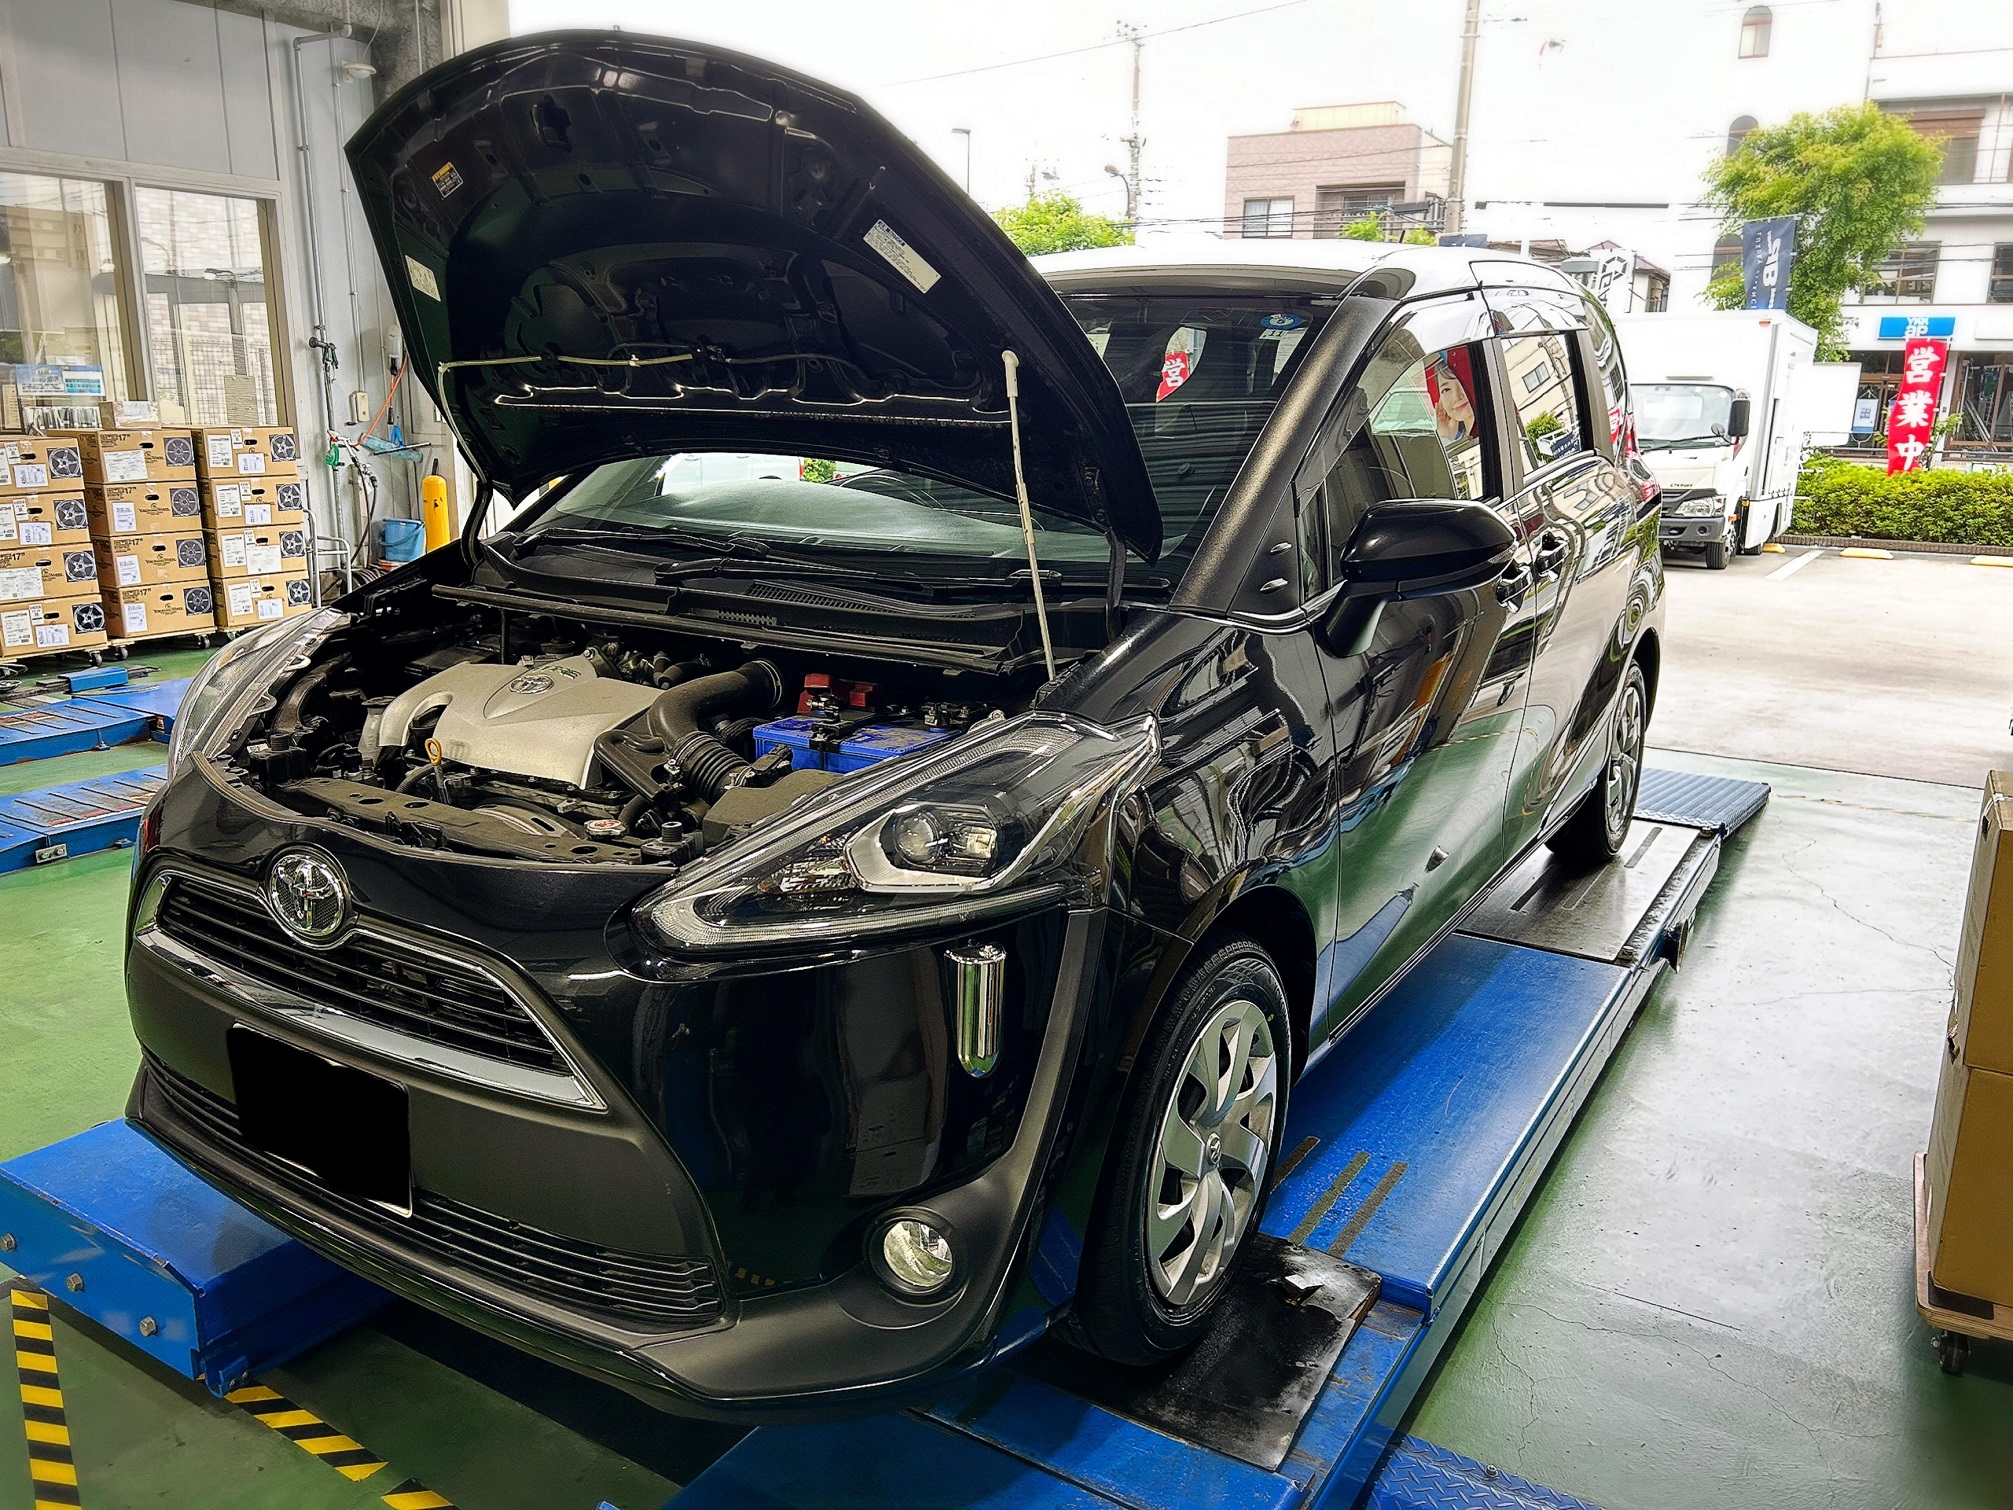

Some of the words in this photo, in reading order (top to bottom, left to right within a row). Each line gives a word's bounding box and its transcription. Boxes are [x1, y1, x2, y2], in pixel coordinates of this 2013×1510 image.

[1904, 325, 1929, 337] ap
[1906, 316, 1930, 326] YKK
[1161, 358, 1186, 388] 営
[1894, 346, 1941, 471] 営業中
